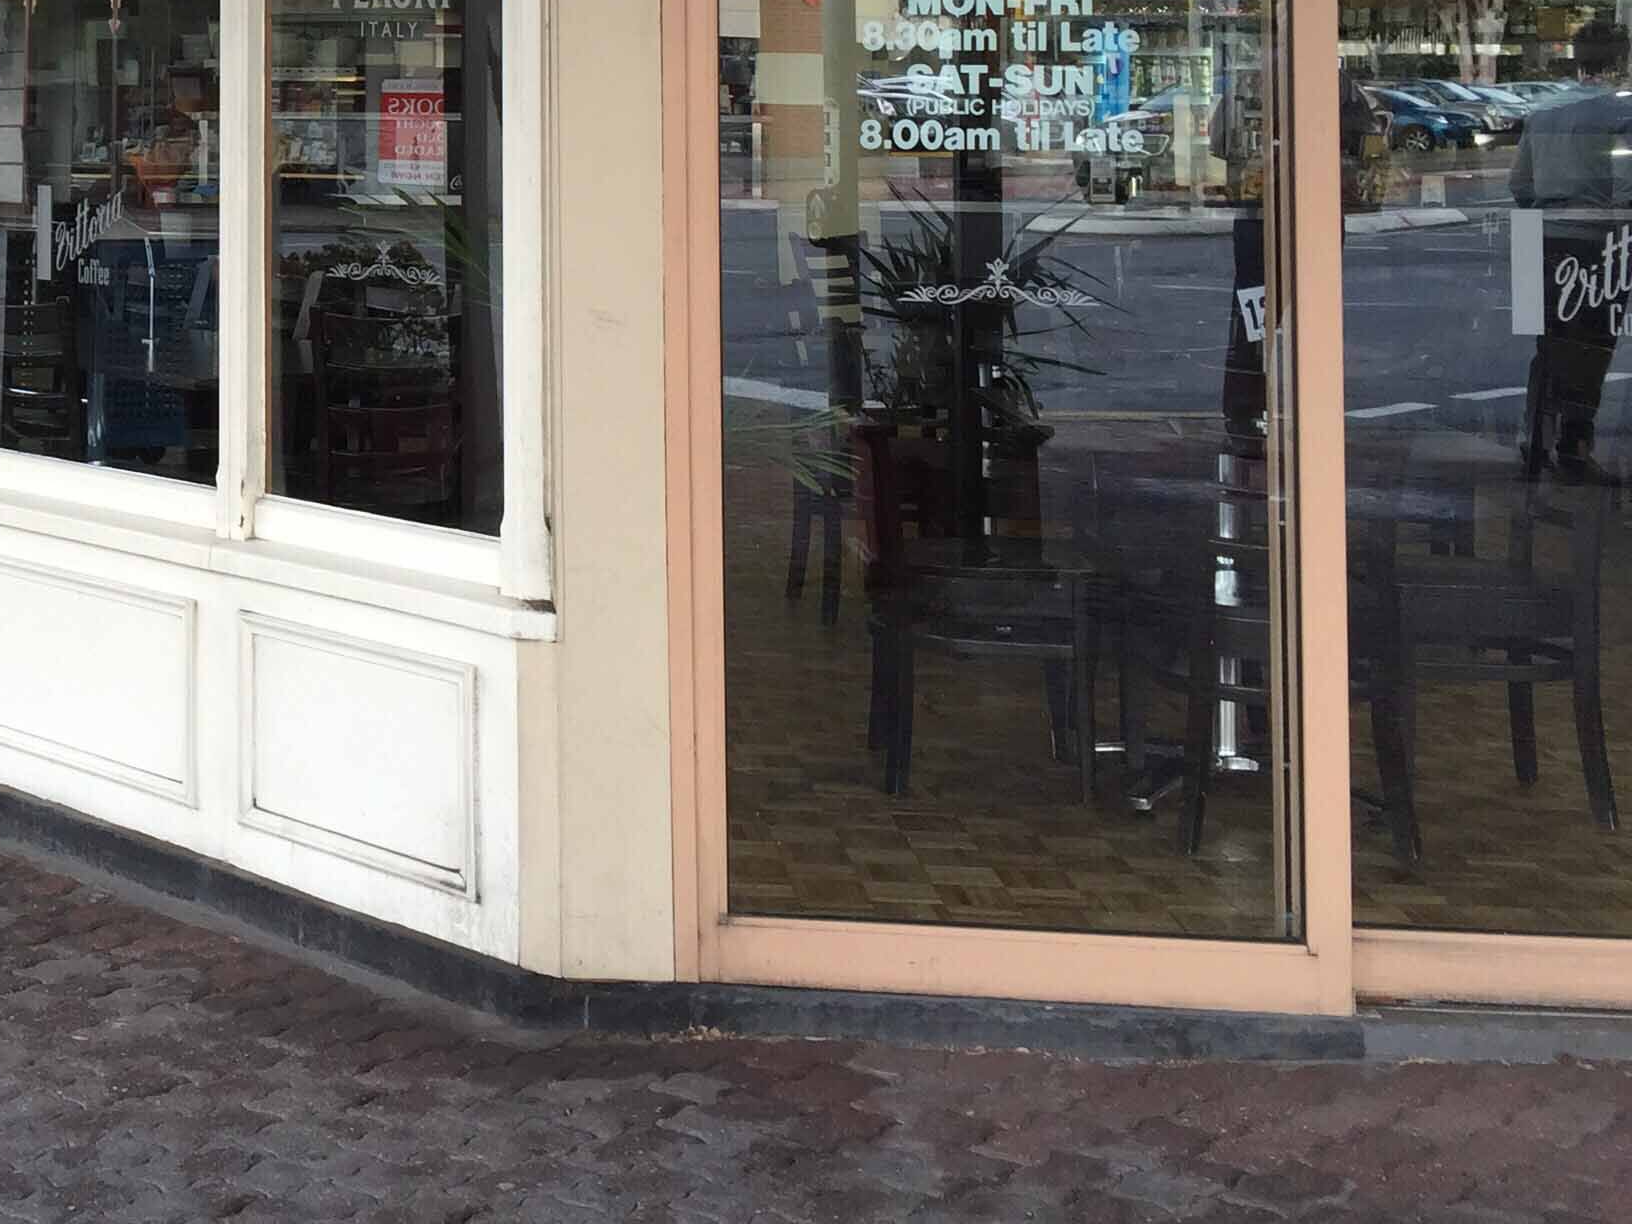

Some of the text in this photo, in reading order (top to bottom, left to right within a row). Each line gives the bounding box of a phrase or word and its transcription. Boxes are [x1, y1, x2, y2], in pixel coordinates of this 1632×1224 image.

[359, 20, 418, 39] ITALY
[862, 20, 1141, 54] 8.30am til Late
[906, 63, 1095, 97] SAT-SUN
[906, 97, 1097, 119] (PUBLIC HOLIDAYS)
[859, 119, 1146, 153] 8.00am til Late
[54, 187, 126, 273] Vittoria
[77, 257, 111, 287] Coffee
